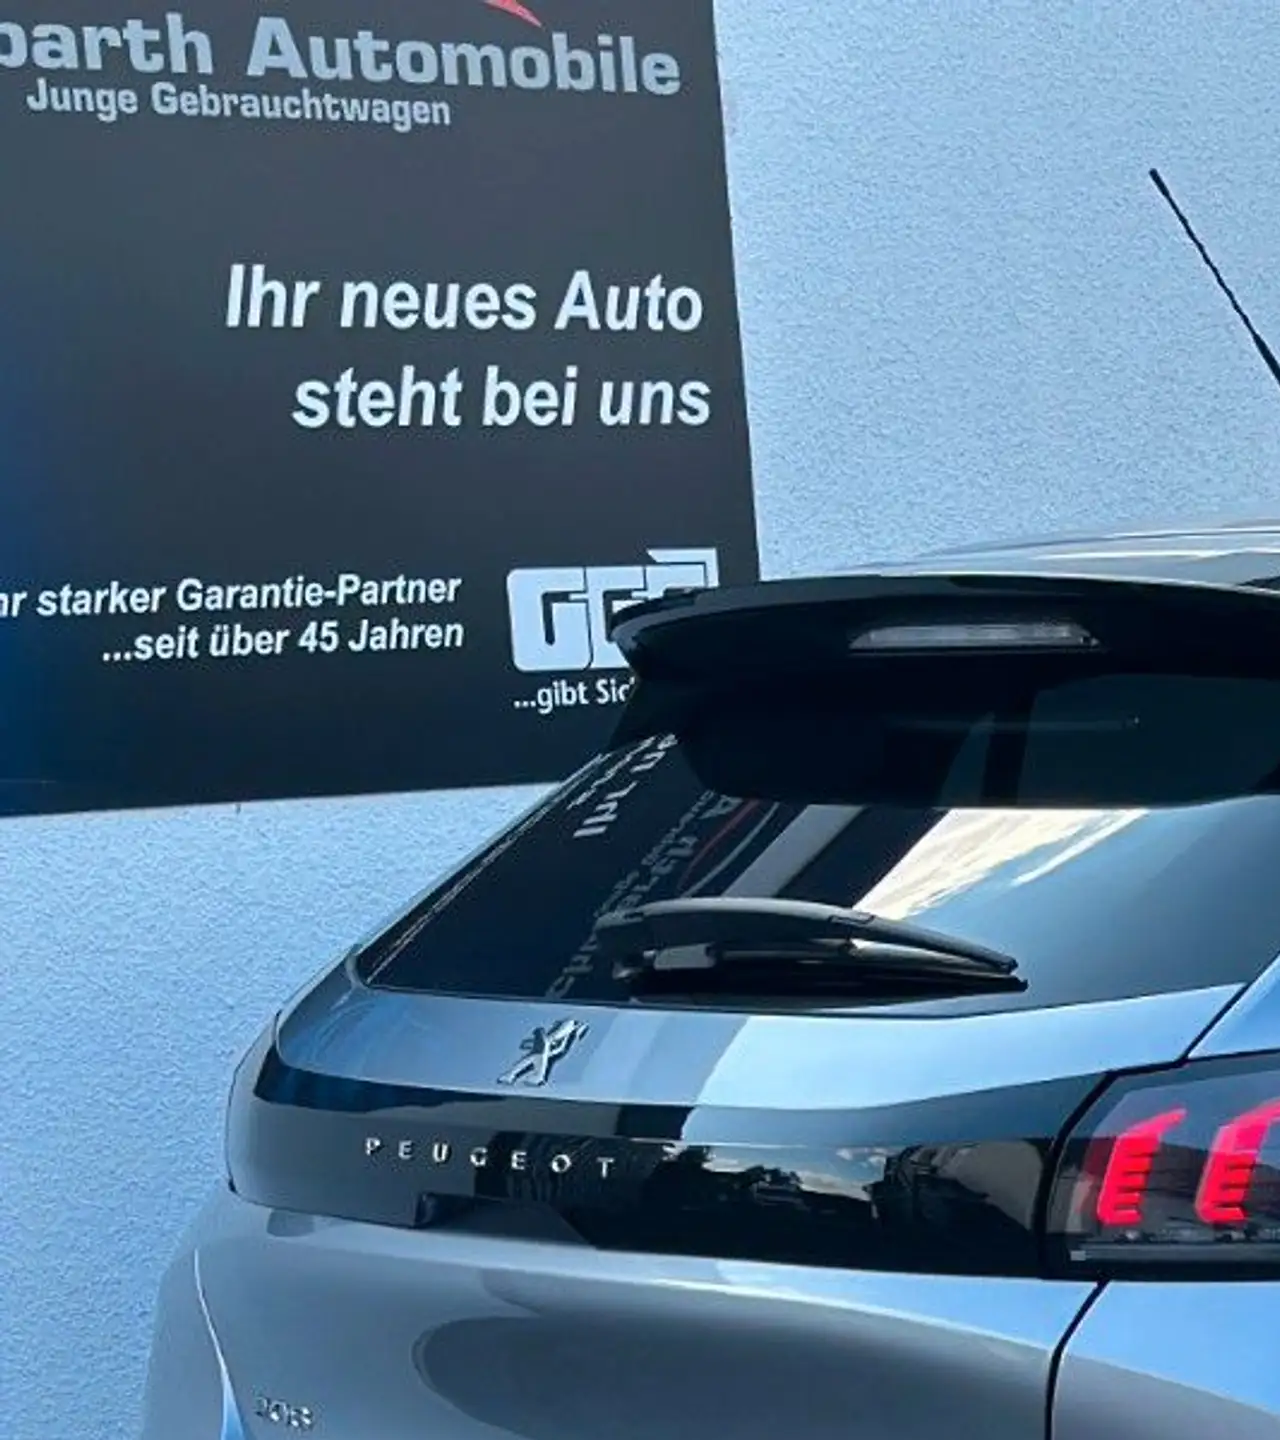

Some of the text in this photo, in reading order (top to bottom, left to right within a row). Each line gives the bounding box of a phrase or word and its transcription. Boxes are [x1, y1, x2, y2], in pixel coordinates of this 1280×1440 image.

[246, 16, 681, 95] Automobile
[26, 77, 451, 132] Junge Gebrauchtwagen
[226, 264, 703, 330] Ihr neues Auto
[292, 365, 711, 428] steht bei uns
[36, 580, 167, 617] starker
[176, 573, 462, 612] Garantie-Partner
[102, 618, 464, 661] ...seit über 45 Jahren
[365, 1136, 616, 1179] PEUGEOT
